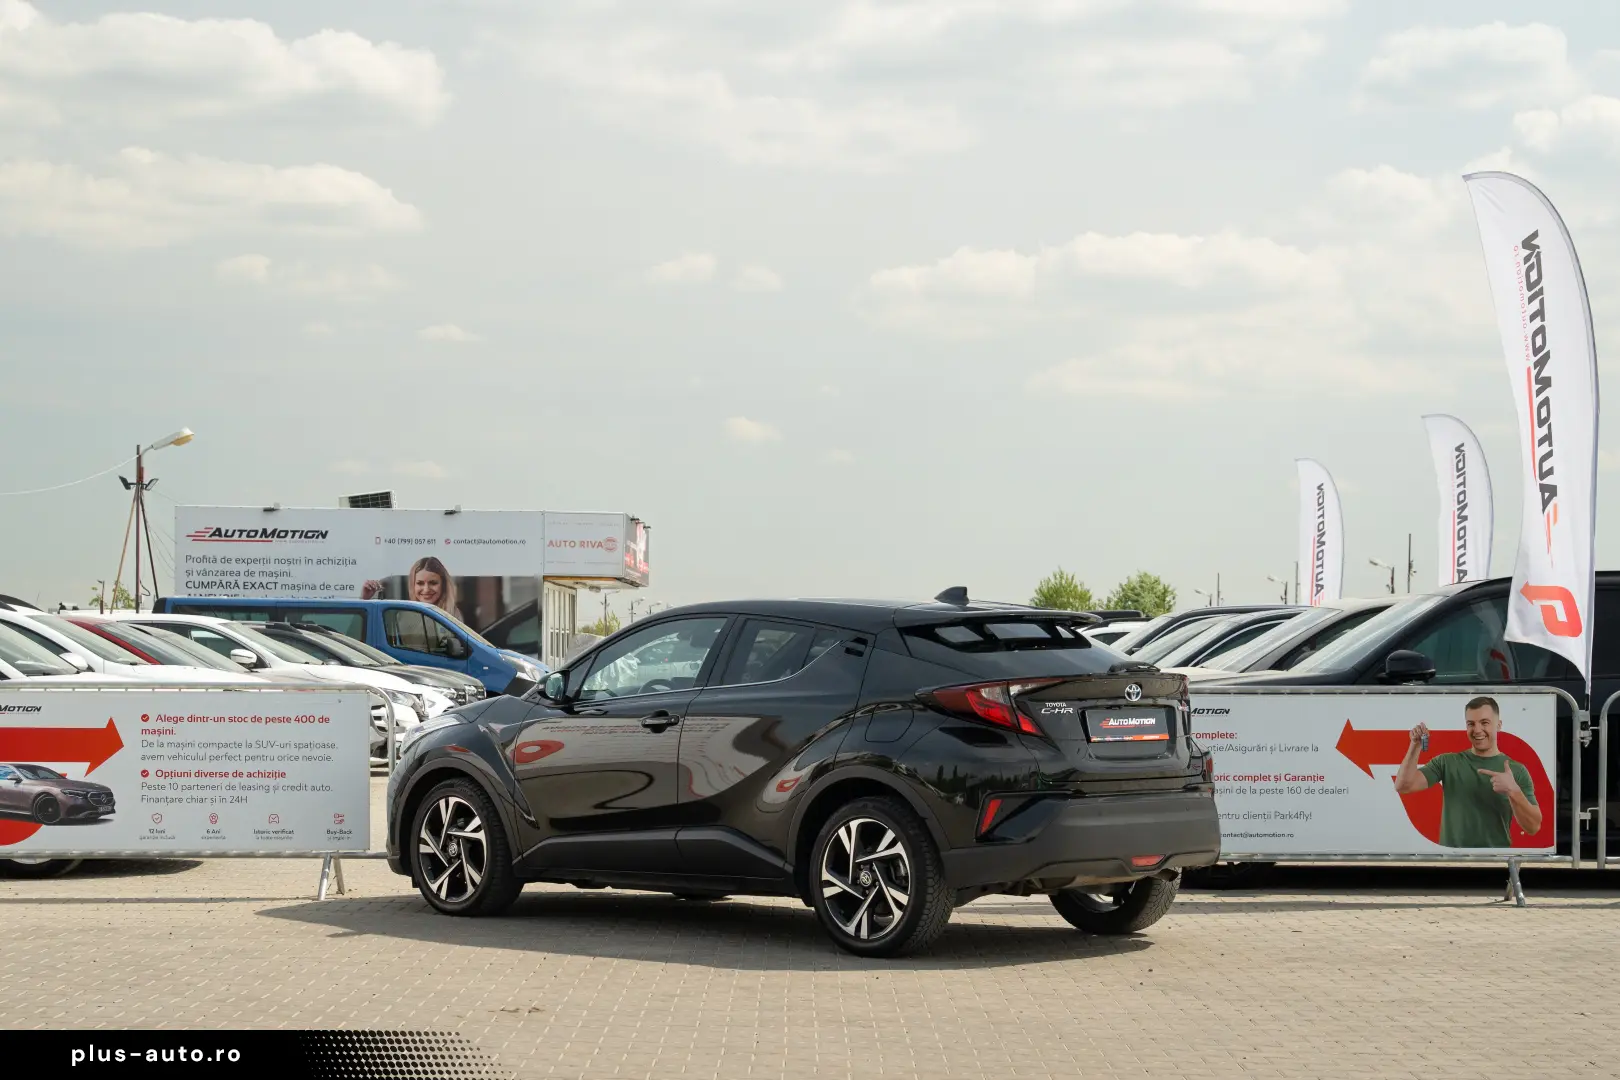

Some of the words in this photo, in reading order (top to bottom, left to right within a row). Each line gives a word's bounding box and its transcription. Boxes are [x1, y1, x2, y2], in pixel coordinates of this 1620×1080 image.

[453, 538, 526, 546] contact@automotion.ro
[547, 540, 576, 548] AUTO
[579, 540, 604, 548] RIVA
[185, 554, 218, 564] Profită
[220, 556, 233, 565] de
[235, 555, 271, 567] experții
[273, 556, 302, 567] noștri
[304, 556, 314, 566] în
[316, 556, 357, 567] achiziția
[185, 568, 194, 578] și
[196, 567, 241, 577] vânzarea
[243, 568, 256, 578] de
[185, 579, 241, 590] CUMPĂRĂ
[242, 581, 279, 590] EXACT
[281, 582, 317, 592] mașina
[319, 581, 332, 591] de
[155, 714, 185, 725] Alege
[187, 714, 226, 724] dintr-un
[228, 715, 249, 724] stoc
[250, 715, 263, 724] de
[265, 715, 292, 725] peste
[294, 715, 316, 724] 400
[318, 715, 330, 724] de
[141, 728, 177, 738] mașini.
[141, 739, 155, 749] De
[157, 739, 165, 749] la
[167, 740, 196, 751] mașini
[197, 741, 243, 751] compacte
[245, 739, 253, 749] la
[254, 740, 292, 749] SUV-uri
[1270, 744, 1277, 755] și
[1279, 744, 1309, 753] Livrare
[1311, 744, 1319, 753] la
[141, 754, 166, 762] avem
[167, 752, 207, 762] vehiculul
[208, 752, 242, 764] perfect
[244, 754, 275, 764] pentru
[277, 753, 300, 763] orice
[302, 753, 334, 763] nevoie.
[155, 769, 192, 780] Opțiuni
[194, 769, 230, 779] diverse
[232, 769, 244, 779] de
[247, 769, 287, 780] achiziție
[1232, 772, 1272, 784] complet
[1274, 772, 1282, 784] și
[1284, 772, 1325, 784] Garanție
[141, 782, 166, 792] Peste
[168, 782, 179, 792] 10
[181, 783, 223, 794] parteneri
[225, 782, 237, 792] de
[239, 783, 270, 794] leasing
[273, 783, 279, 794] și
[282, 783, 308, 793] credit
[310, 784, 333, 793] auto.
[1235, 785, 1247, 795] de
[1249, 785, 1257, 795] la
[1259, 787, 1284, 797] peste
[1287, 786, 1302, 795] 160
[1304, 786, 1315, 795] de
[1318, 786, 1349, 795] dealeri
[141, 795, 183, 806] Finanțare
[185, 795, 207, 804] chiar
[210, 795, 217, 806] și
[229, 795, 248, 804] 24H
[1242, 811, 1272, 823] clienții
[1274, 811, 1313, 822] Park4fly!
